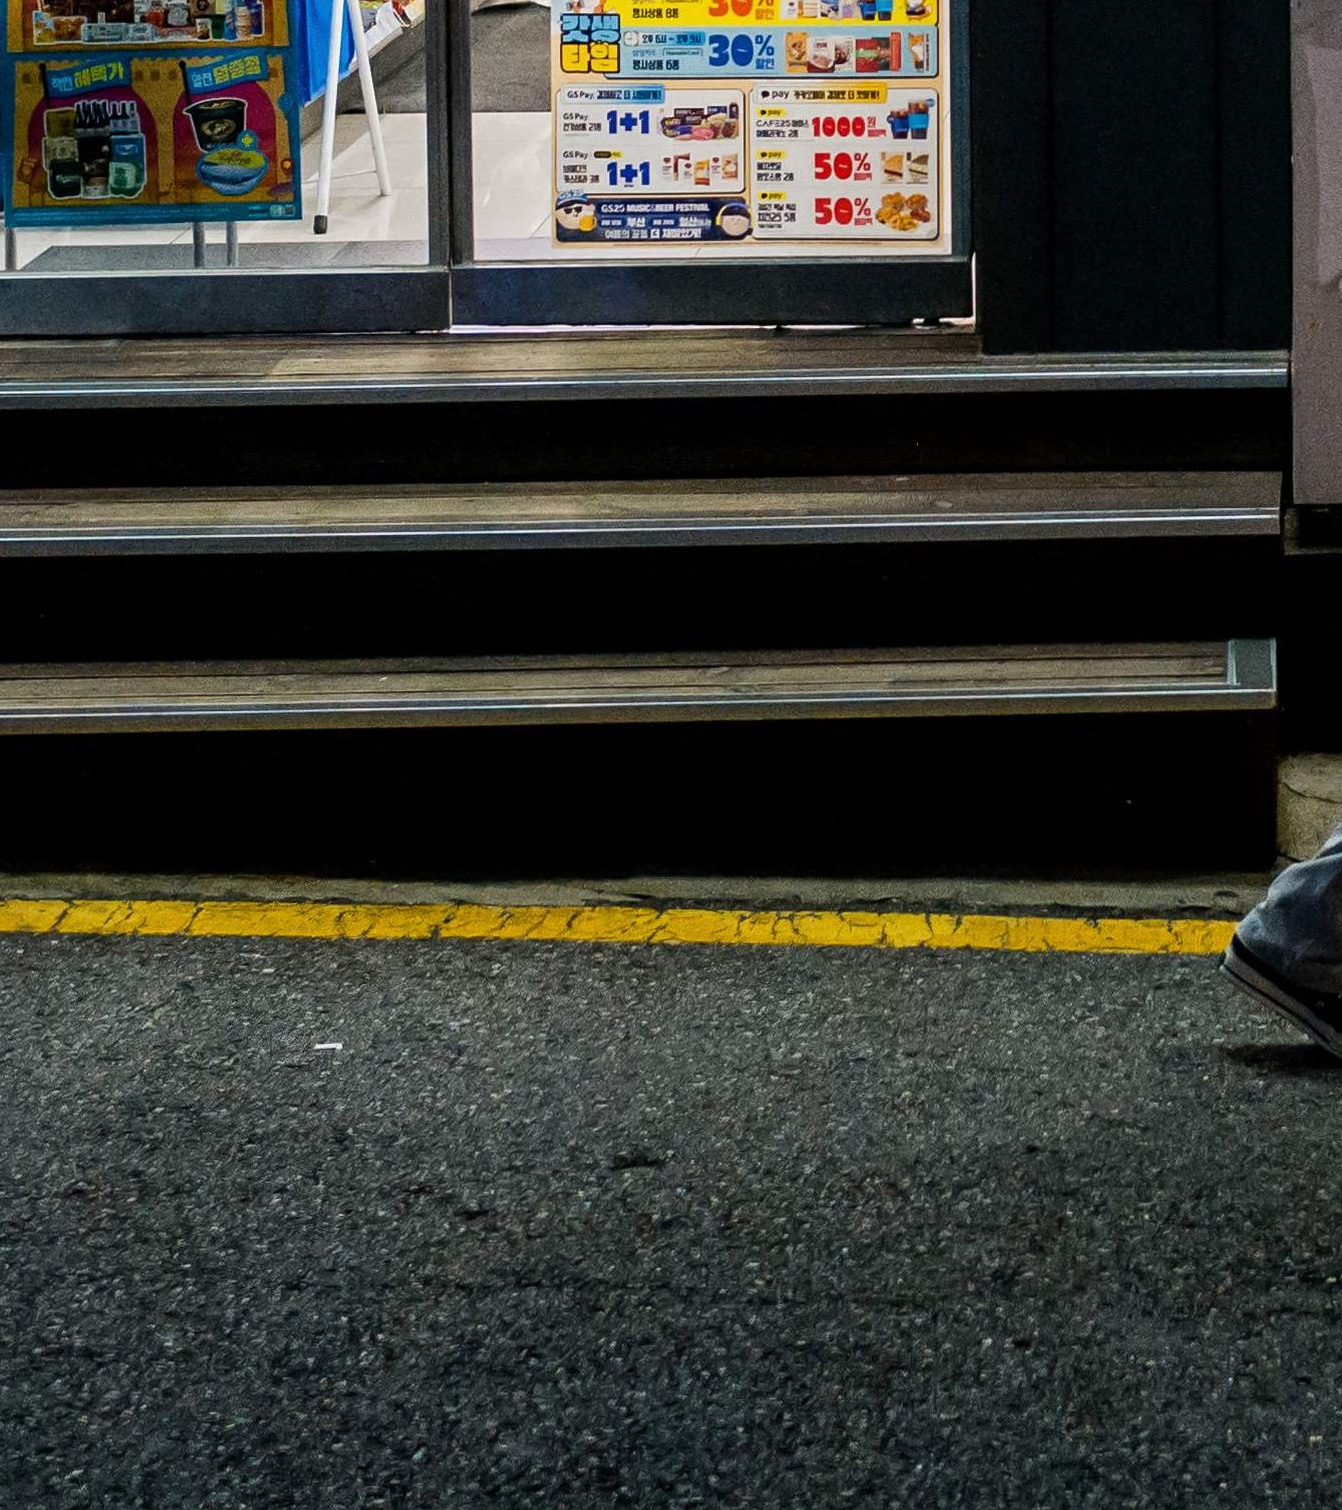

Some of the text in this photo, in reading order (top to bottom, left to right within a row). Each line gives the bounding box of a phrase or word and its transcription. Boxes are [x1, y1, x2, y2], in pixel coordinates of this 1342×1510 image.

[709, 34, 774, 67] 30%
[772, 91, 789, 99] pay
[575, 113, 587, 121] Pay
[607, 111, 649, 134] 1+1
[575, 151, 588, 160] Pay
[815, 153, 871, 180] 50%
[607, 162, 649, 185] 1+1
[815, 198, 871, 225] 50%
